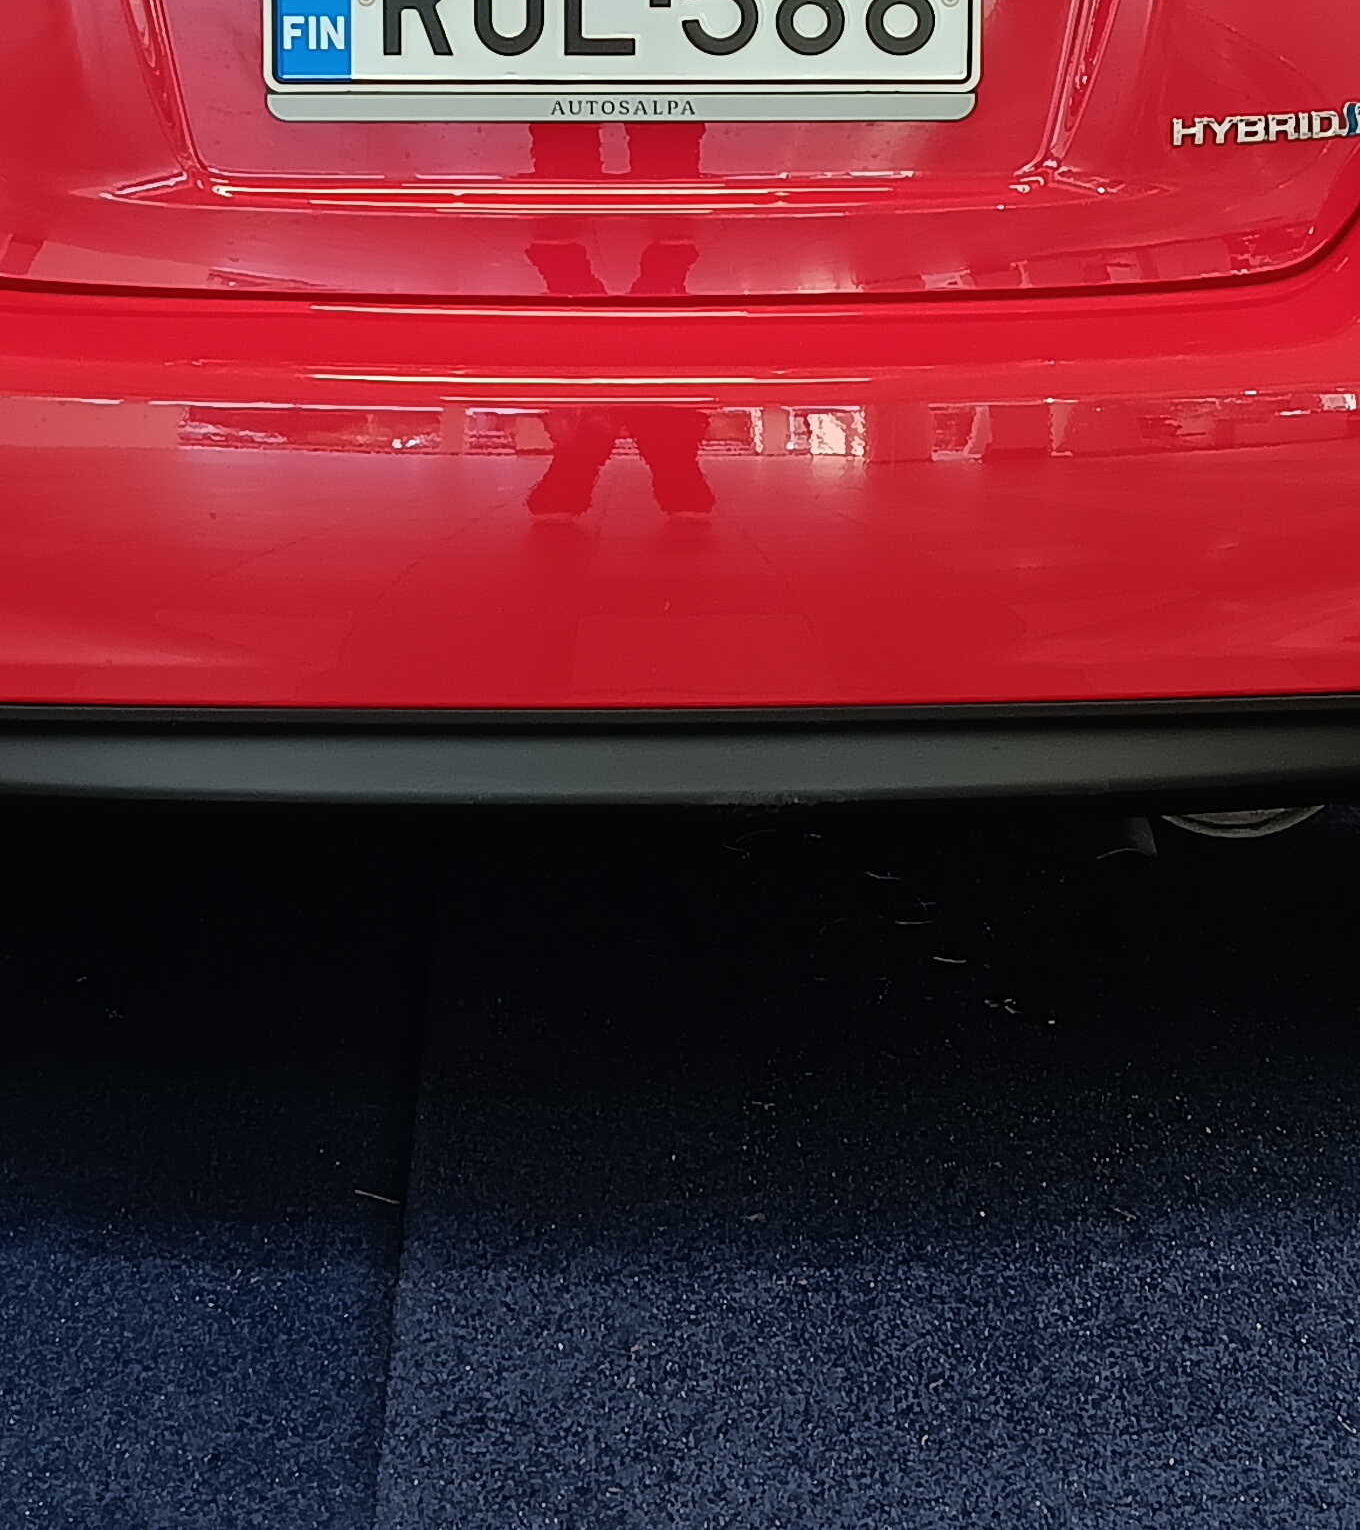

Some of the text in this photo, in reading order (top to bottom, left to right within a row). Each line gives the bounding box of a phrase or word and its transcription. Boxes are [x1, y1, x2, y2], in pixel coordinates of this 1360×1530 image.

[282, 15, 345, 51] FIN
[551, 100, 696, 116] AUTOSALPA
[1172, 110, 1341, 146] HYBRID
